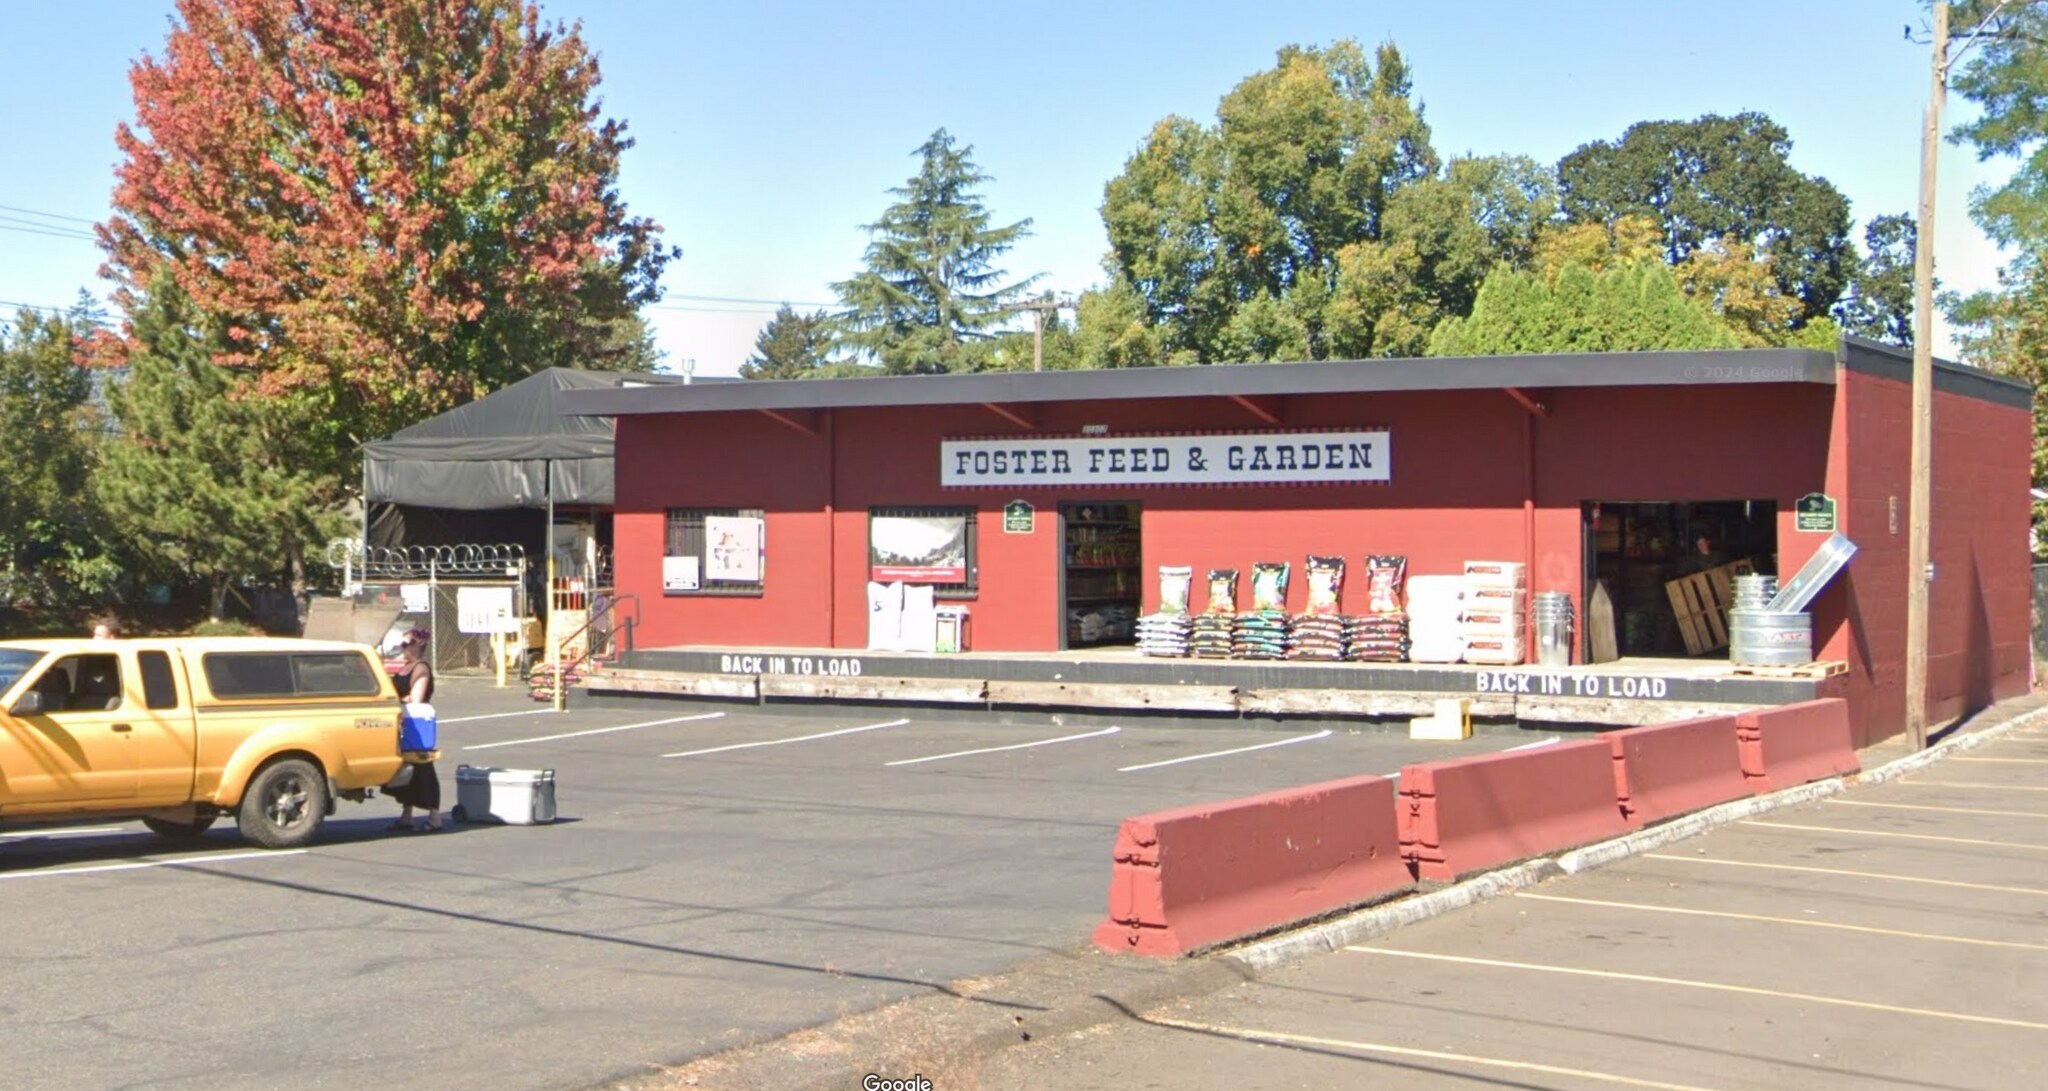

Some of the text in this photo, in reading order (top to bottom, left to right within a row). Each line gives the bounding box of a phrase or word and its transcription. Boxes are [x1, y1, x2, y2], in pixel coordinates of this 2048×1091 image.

[954, 443, 1373, 475] FOSTER FEED & GARDEN
[721, 655, 861, 676] BACK IN TO LOAD
[1475, 671, 1667, 698] BACK IN TO LOAD
